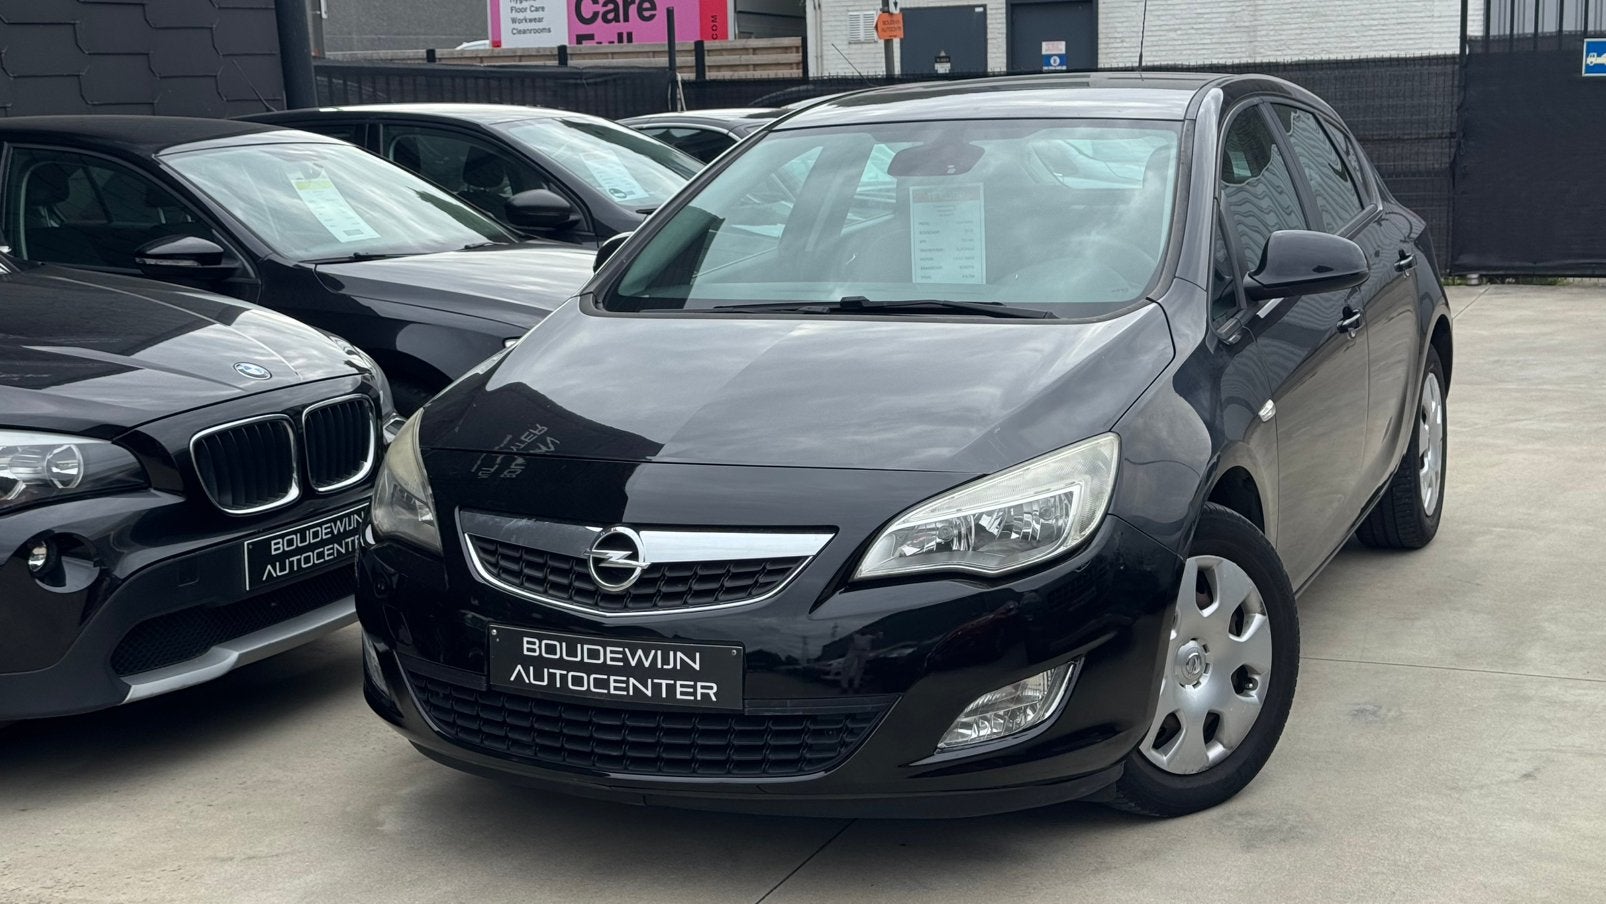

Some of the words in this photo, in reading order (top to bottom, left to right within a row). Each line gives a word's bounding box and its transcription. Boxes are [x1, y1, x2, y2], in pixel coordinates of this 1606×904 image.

[510, 6, 528, 14] Floor
[510, 16, 544, 24] Workwear
[575, 0, 657, 25] Care
[511, 27, 551, 35] Cleanrooms
[271, 511, 364, 555] BOUDEWIJN
[523, 636, 701, 671] BOUDEWIJN
[510, 664, 718, 702] AUTOCENTER
